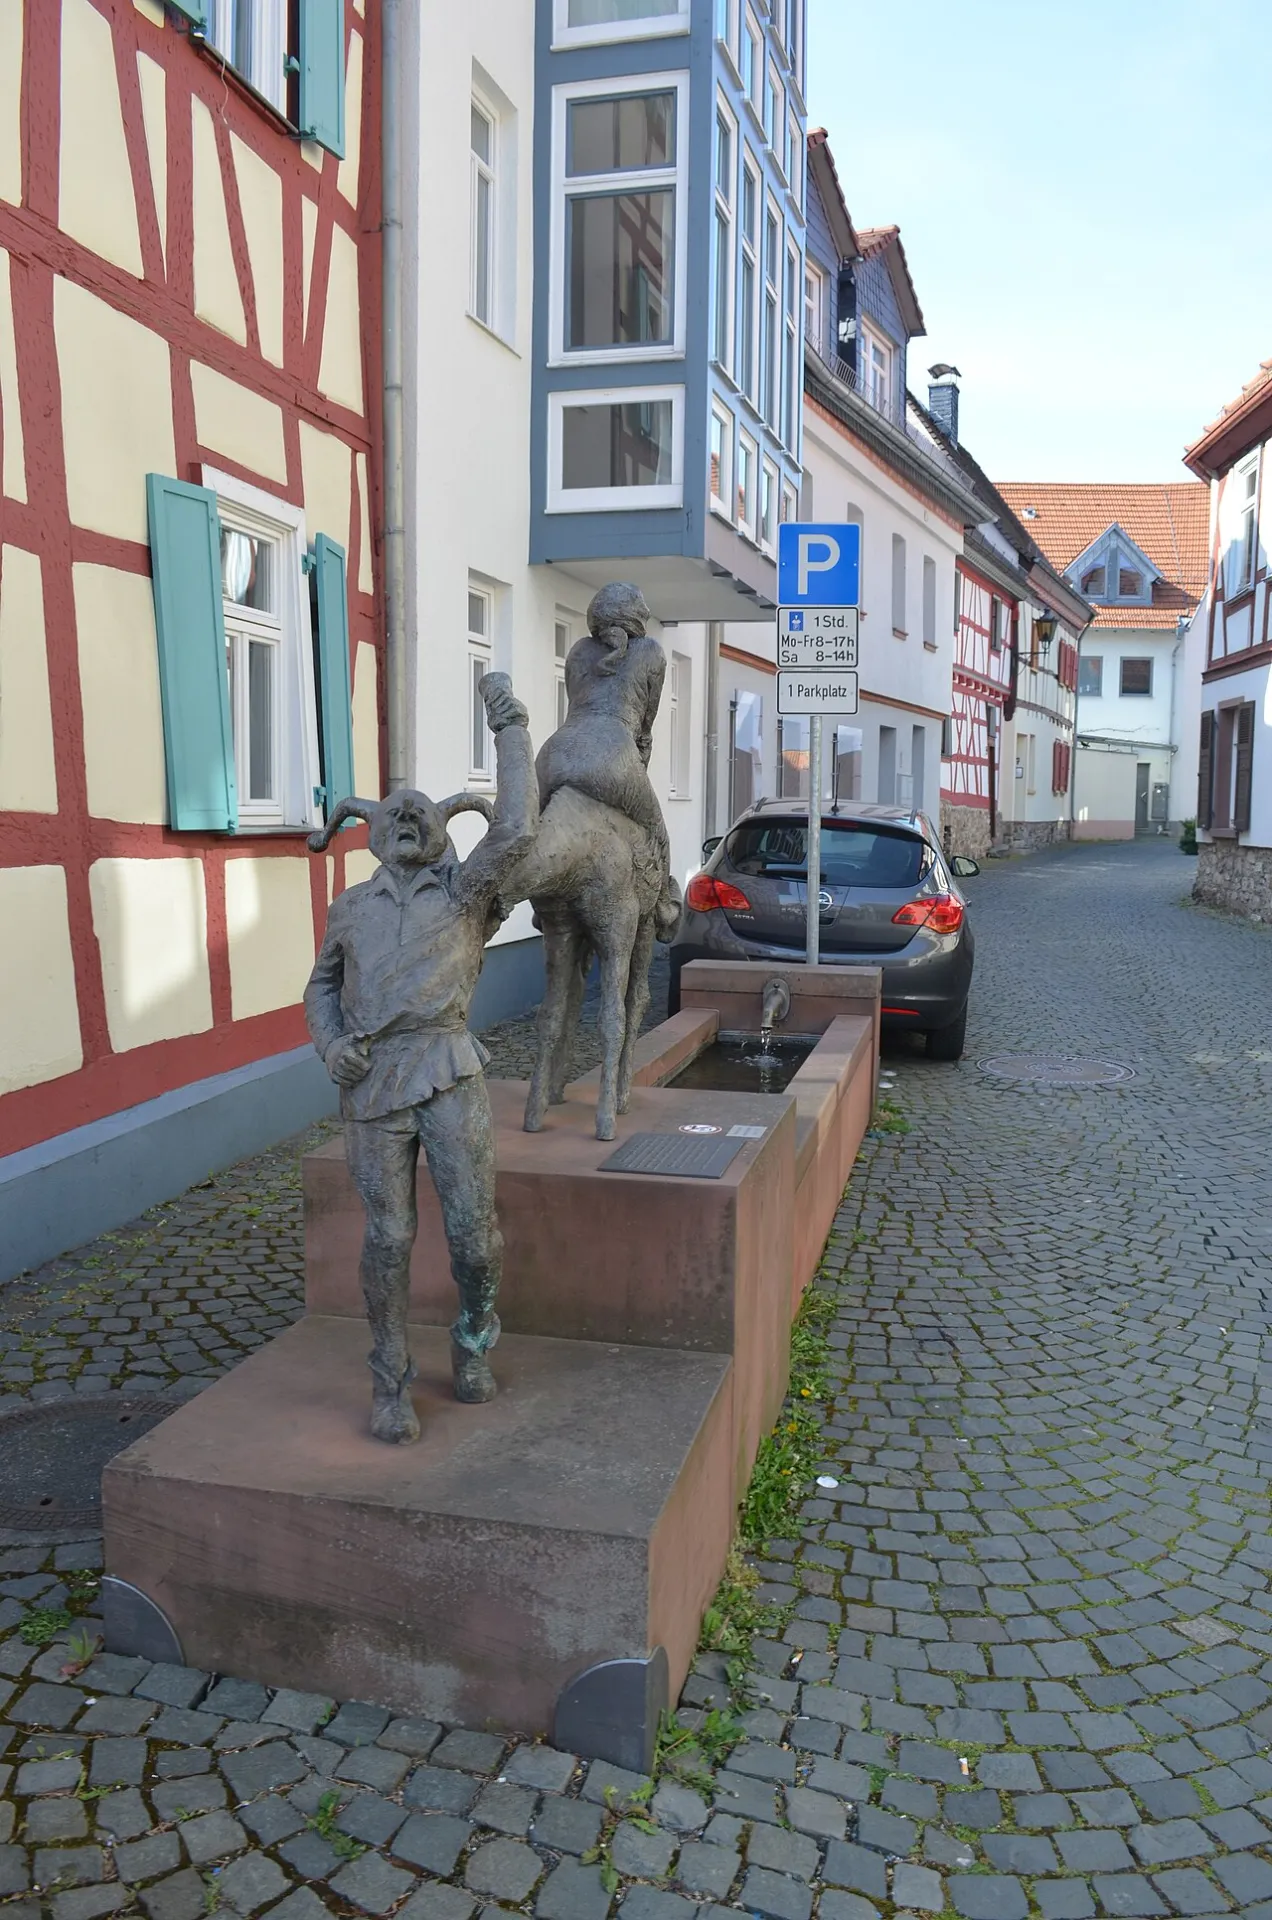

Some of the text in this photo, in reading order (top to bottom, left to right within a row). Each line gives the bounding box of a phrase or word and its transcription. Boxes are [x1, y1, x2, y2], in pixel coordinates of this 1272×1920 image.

[797, 533, 841, 595] P
[814, 615, 849, 628] 1 Std.
[781, 634, 814, 648] Mo-Fr
[781, 650, 798, 663] Sa
[788, 683, 847, 701] 1 Parkplatz
